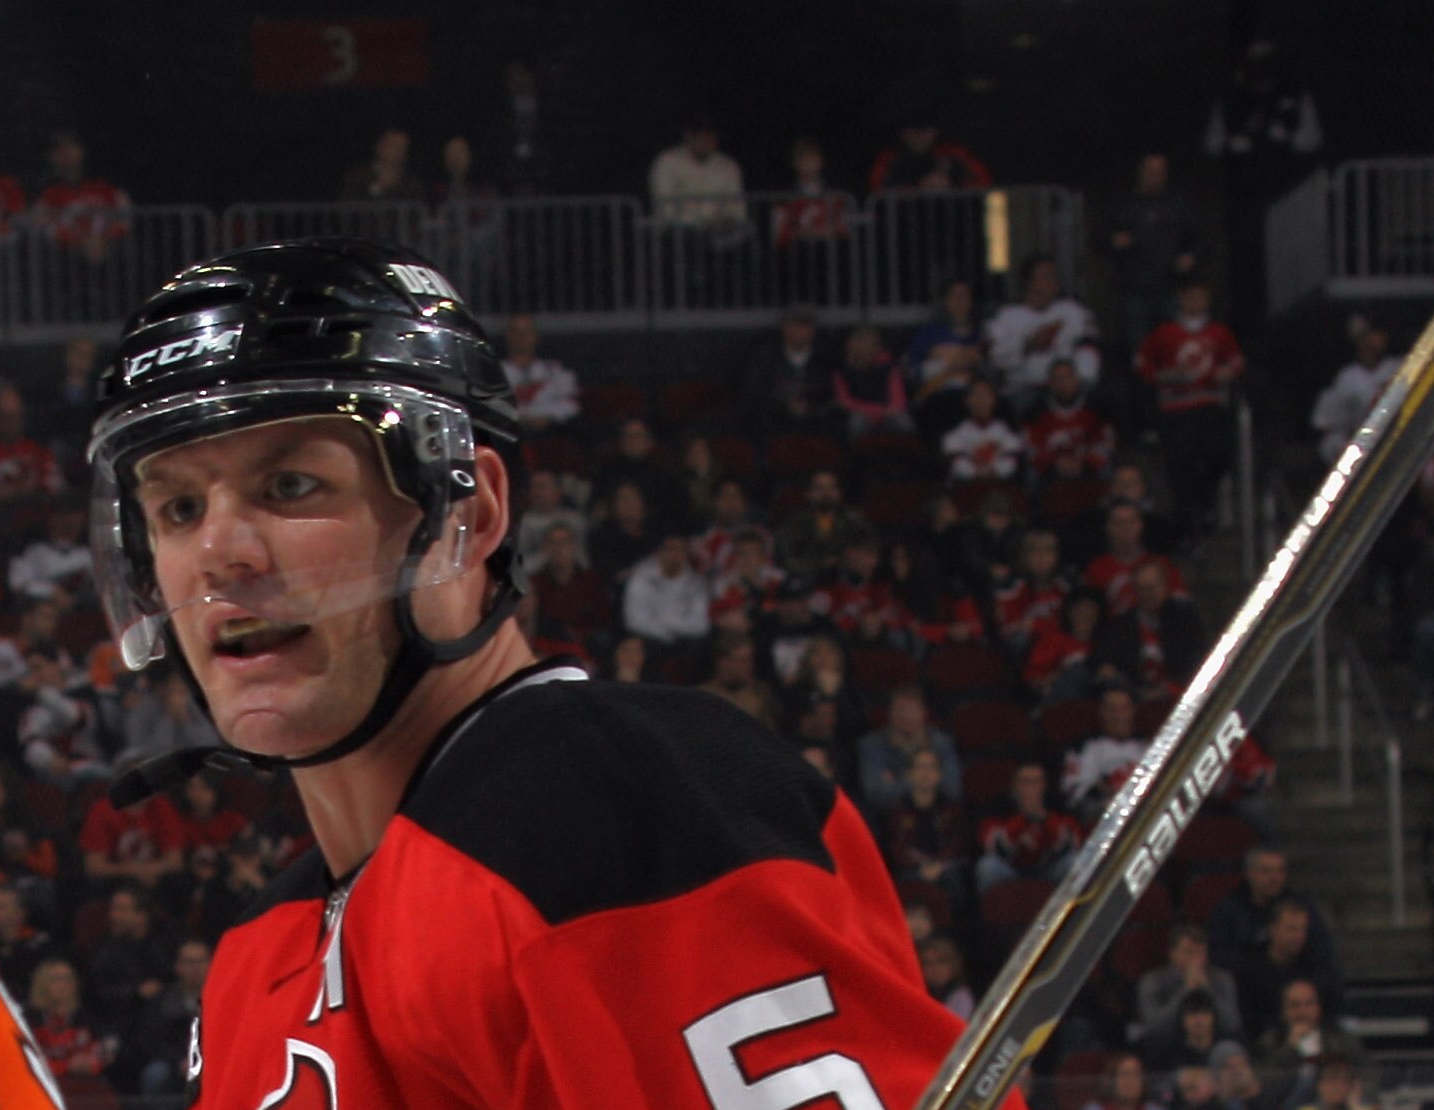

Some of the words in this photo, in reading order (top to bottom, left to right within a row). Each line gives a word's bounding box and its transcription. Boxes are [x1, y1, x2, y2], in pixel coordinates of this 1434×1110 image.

[323, 26, 359, 84] 3
[388, 263, 464, 304] DEV
[128, 329, 243, 378] CCM
[1125, 710, 1247, 897] BAUER
